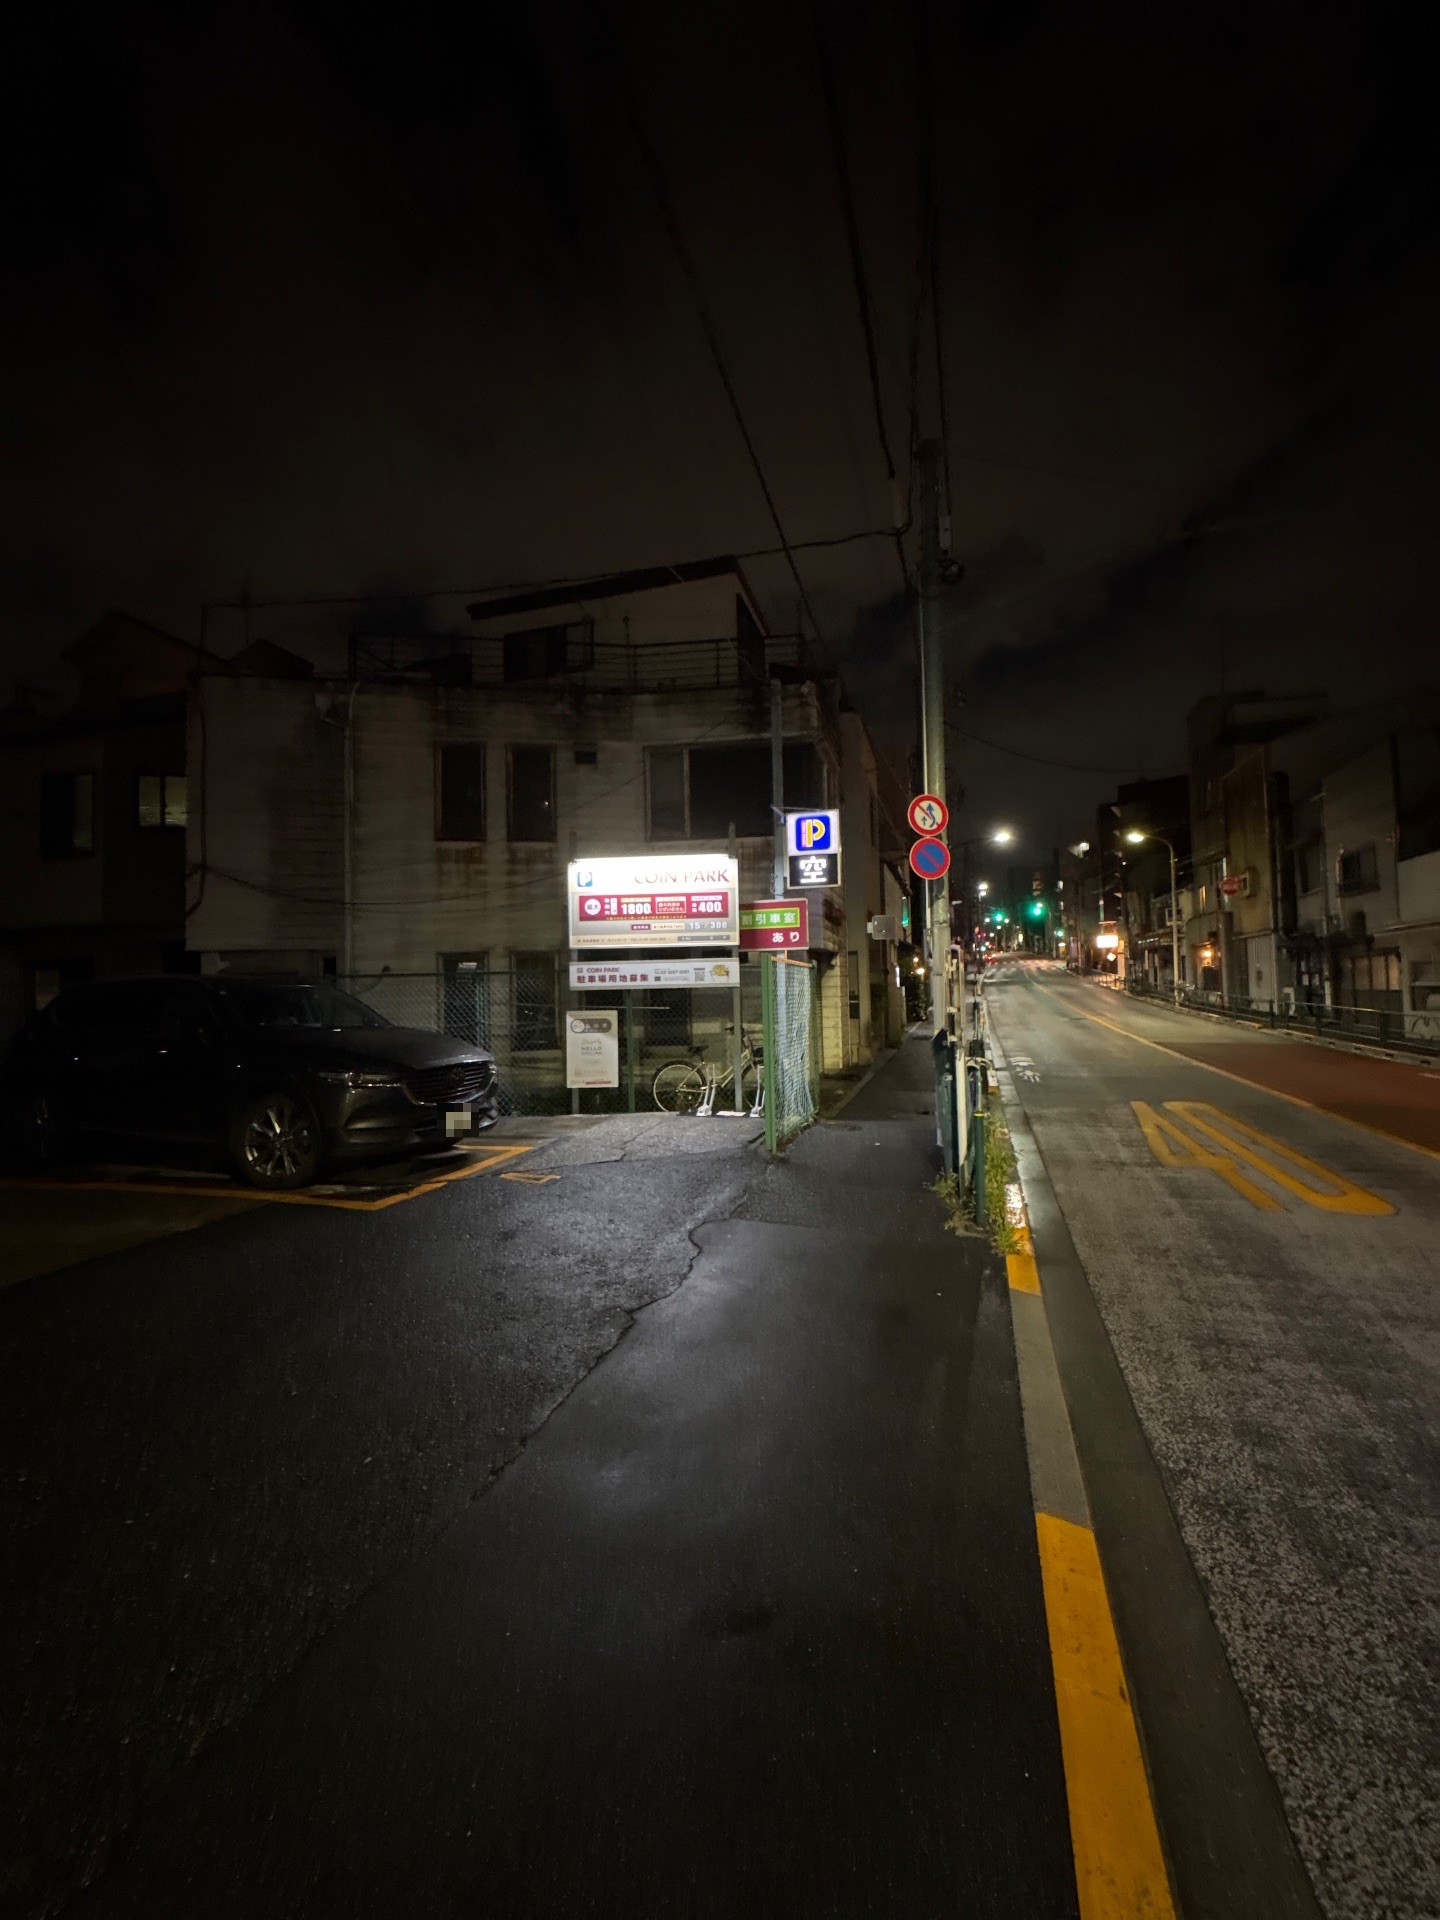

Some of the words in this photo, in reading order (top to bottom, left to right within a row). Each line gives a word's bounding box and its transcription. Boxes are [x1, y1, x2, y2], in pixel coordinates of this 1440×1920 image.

[684, 868, 730, 883] PARK
[799, 855, 828, 884] 空
[772, 931, 800, 943] あり
[576, 973, 649, 984] 駐車場用地募集
[1130, 1100, 1398, 1216] 40
